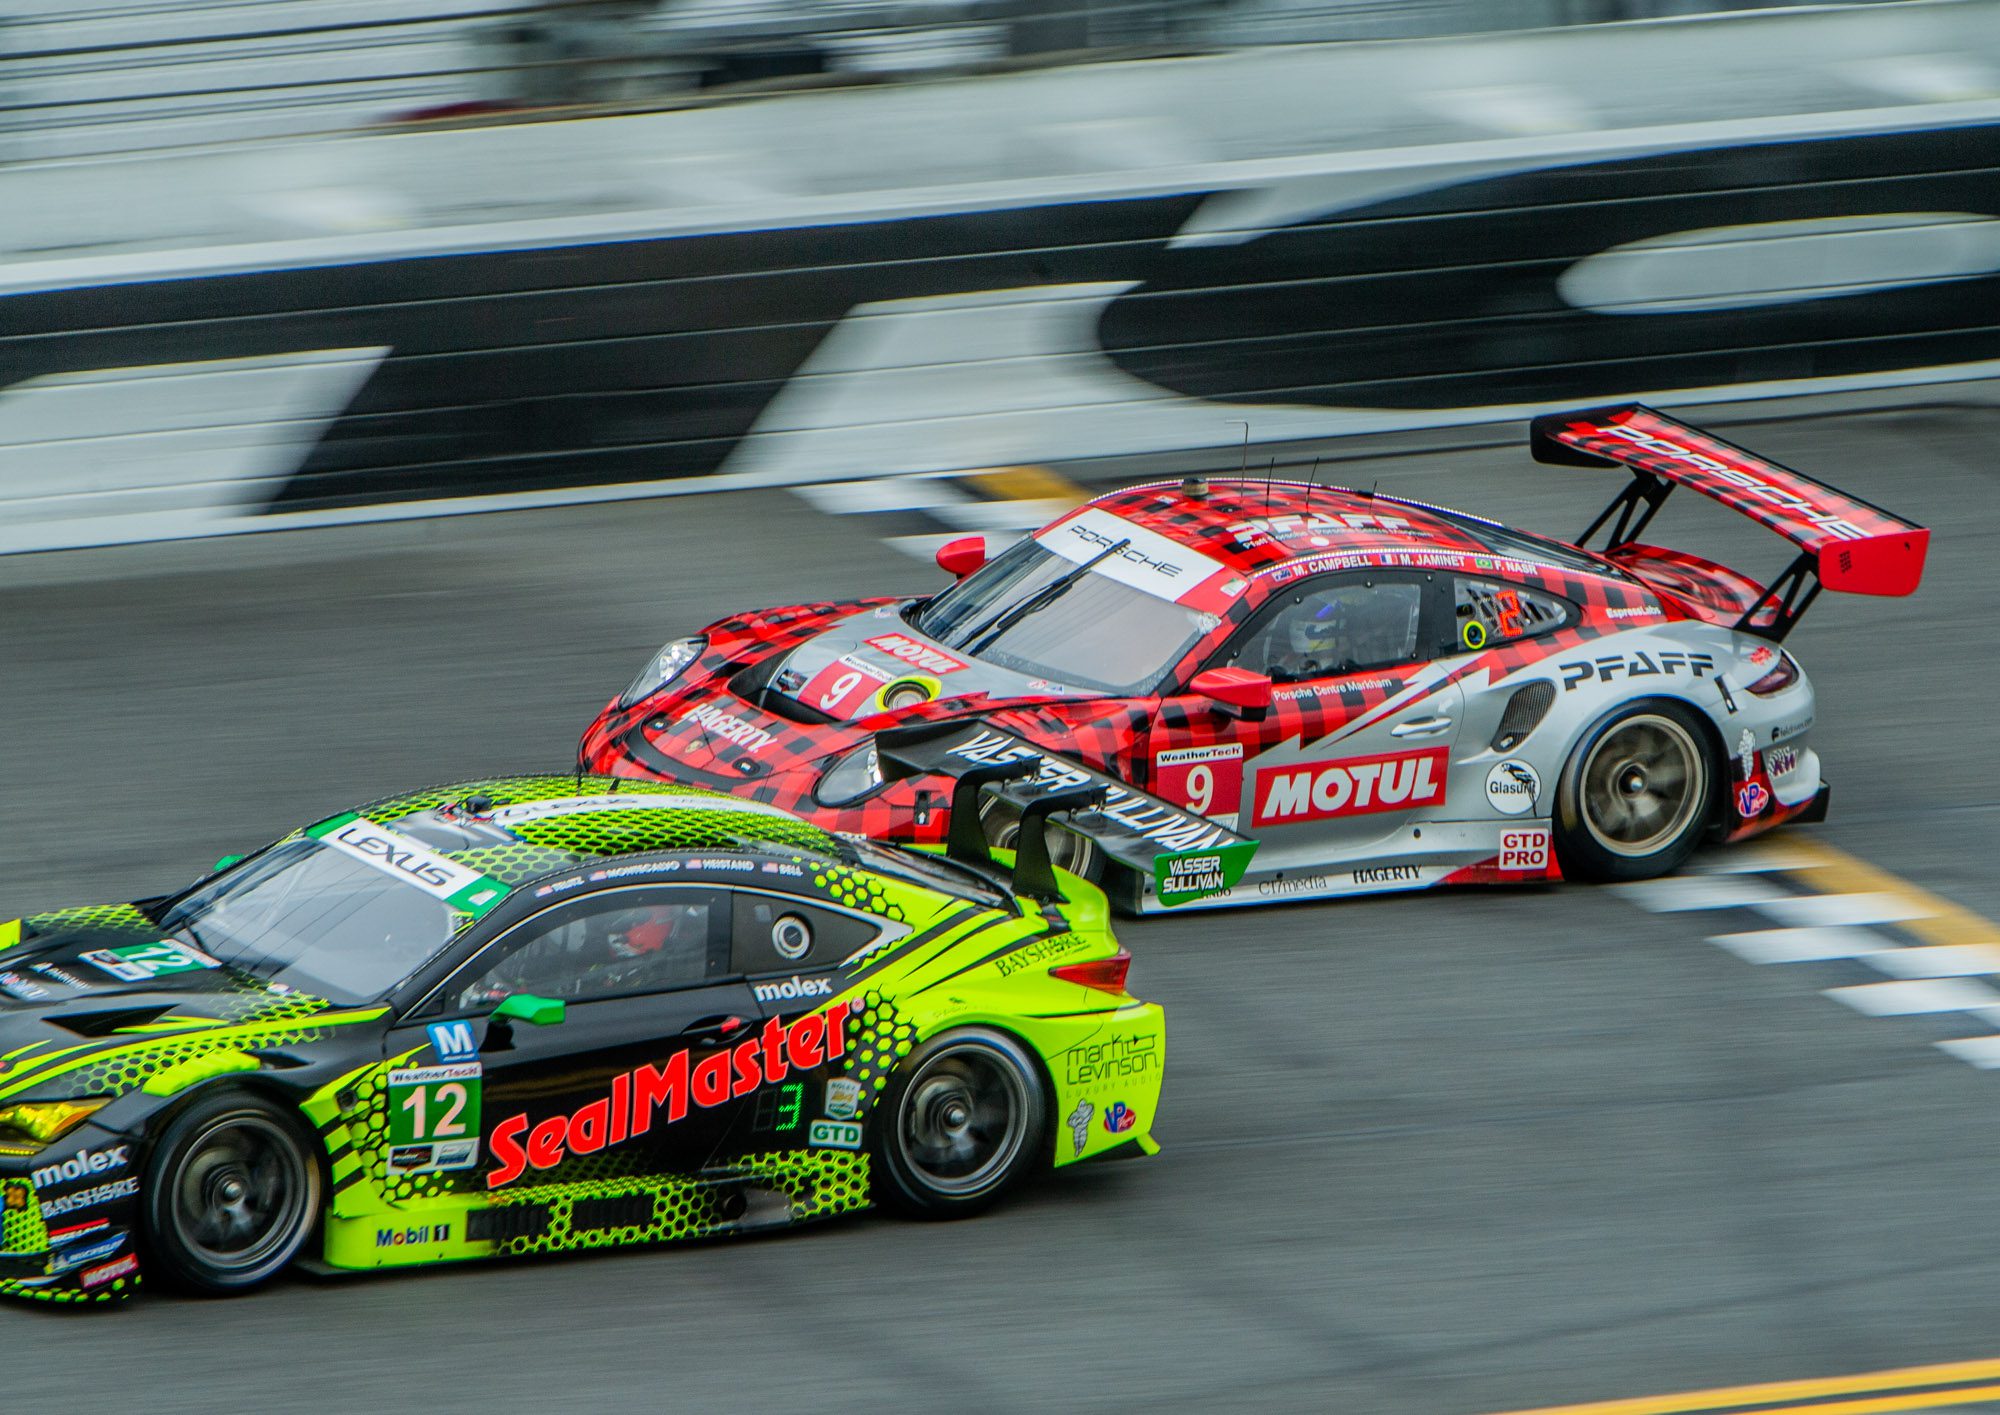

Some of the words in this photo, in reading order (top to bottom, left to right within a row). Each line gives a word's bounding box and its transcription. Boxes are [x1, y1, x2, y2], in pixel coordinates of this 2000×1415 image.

[1597, 425, 1874, 539] PORSCHE
[1226, 512, 1410, 544] PFAFF
[1293, 565, 1307, 577] M.
[1308, 555, 1373, 573] CAMPBELL
[1401, 555, 1415, 567] M.
[1417, 555, 1466, 568] JAMINET
[1494, 561, 1505, 571] F.
[1507, 562, 1538, 576] NASR
[1495, 589, 1523, 637] 2
[870, 635, 960, 674] MOTUL
[1559, 651, 1714, 691] PFAFF
[820, 671, 863, 711] 9
[1273, 687, 1314, 701] Porsche
[1313, 683, 1346, 697] Centre
[1346, 678, 1393, 692] Markham
[677, 702, 778, 753] HAGERTY
[1160, 746, 1240, 762] WeatherTech
[1185, 764, 1214, 816] 9
[1261, 757, 1439, 819] MOTUL
[1503, 833, 1545, 849] GTD
[336, 828, 456, 888] LEXUS
[1168, 855, 1222, 876] VASSER
[1503, 850, 1545, 867] PRO
[1162, 872, 1224, 895] SULLIVAN
[1352, 865, 1422, 885] HAGERTY
[753, 975, 833, 1001] molex
[433, 1023, 475, 1055] M
[392, 1067, 479, 1083] WeatherTech
[486, 998, 853, 1189] SealMaster
[402, 1083, 468, 1139] 12
[1104, 1101, 1127, 1134] VP
[813, 1123, 860, 1143] GTD
[31, 1145, 129, 1190] molex
[375, 1225, 430, 1247] Mobil
